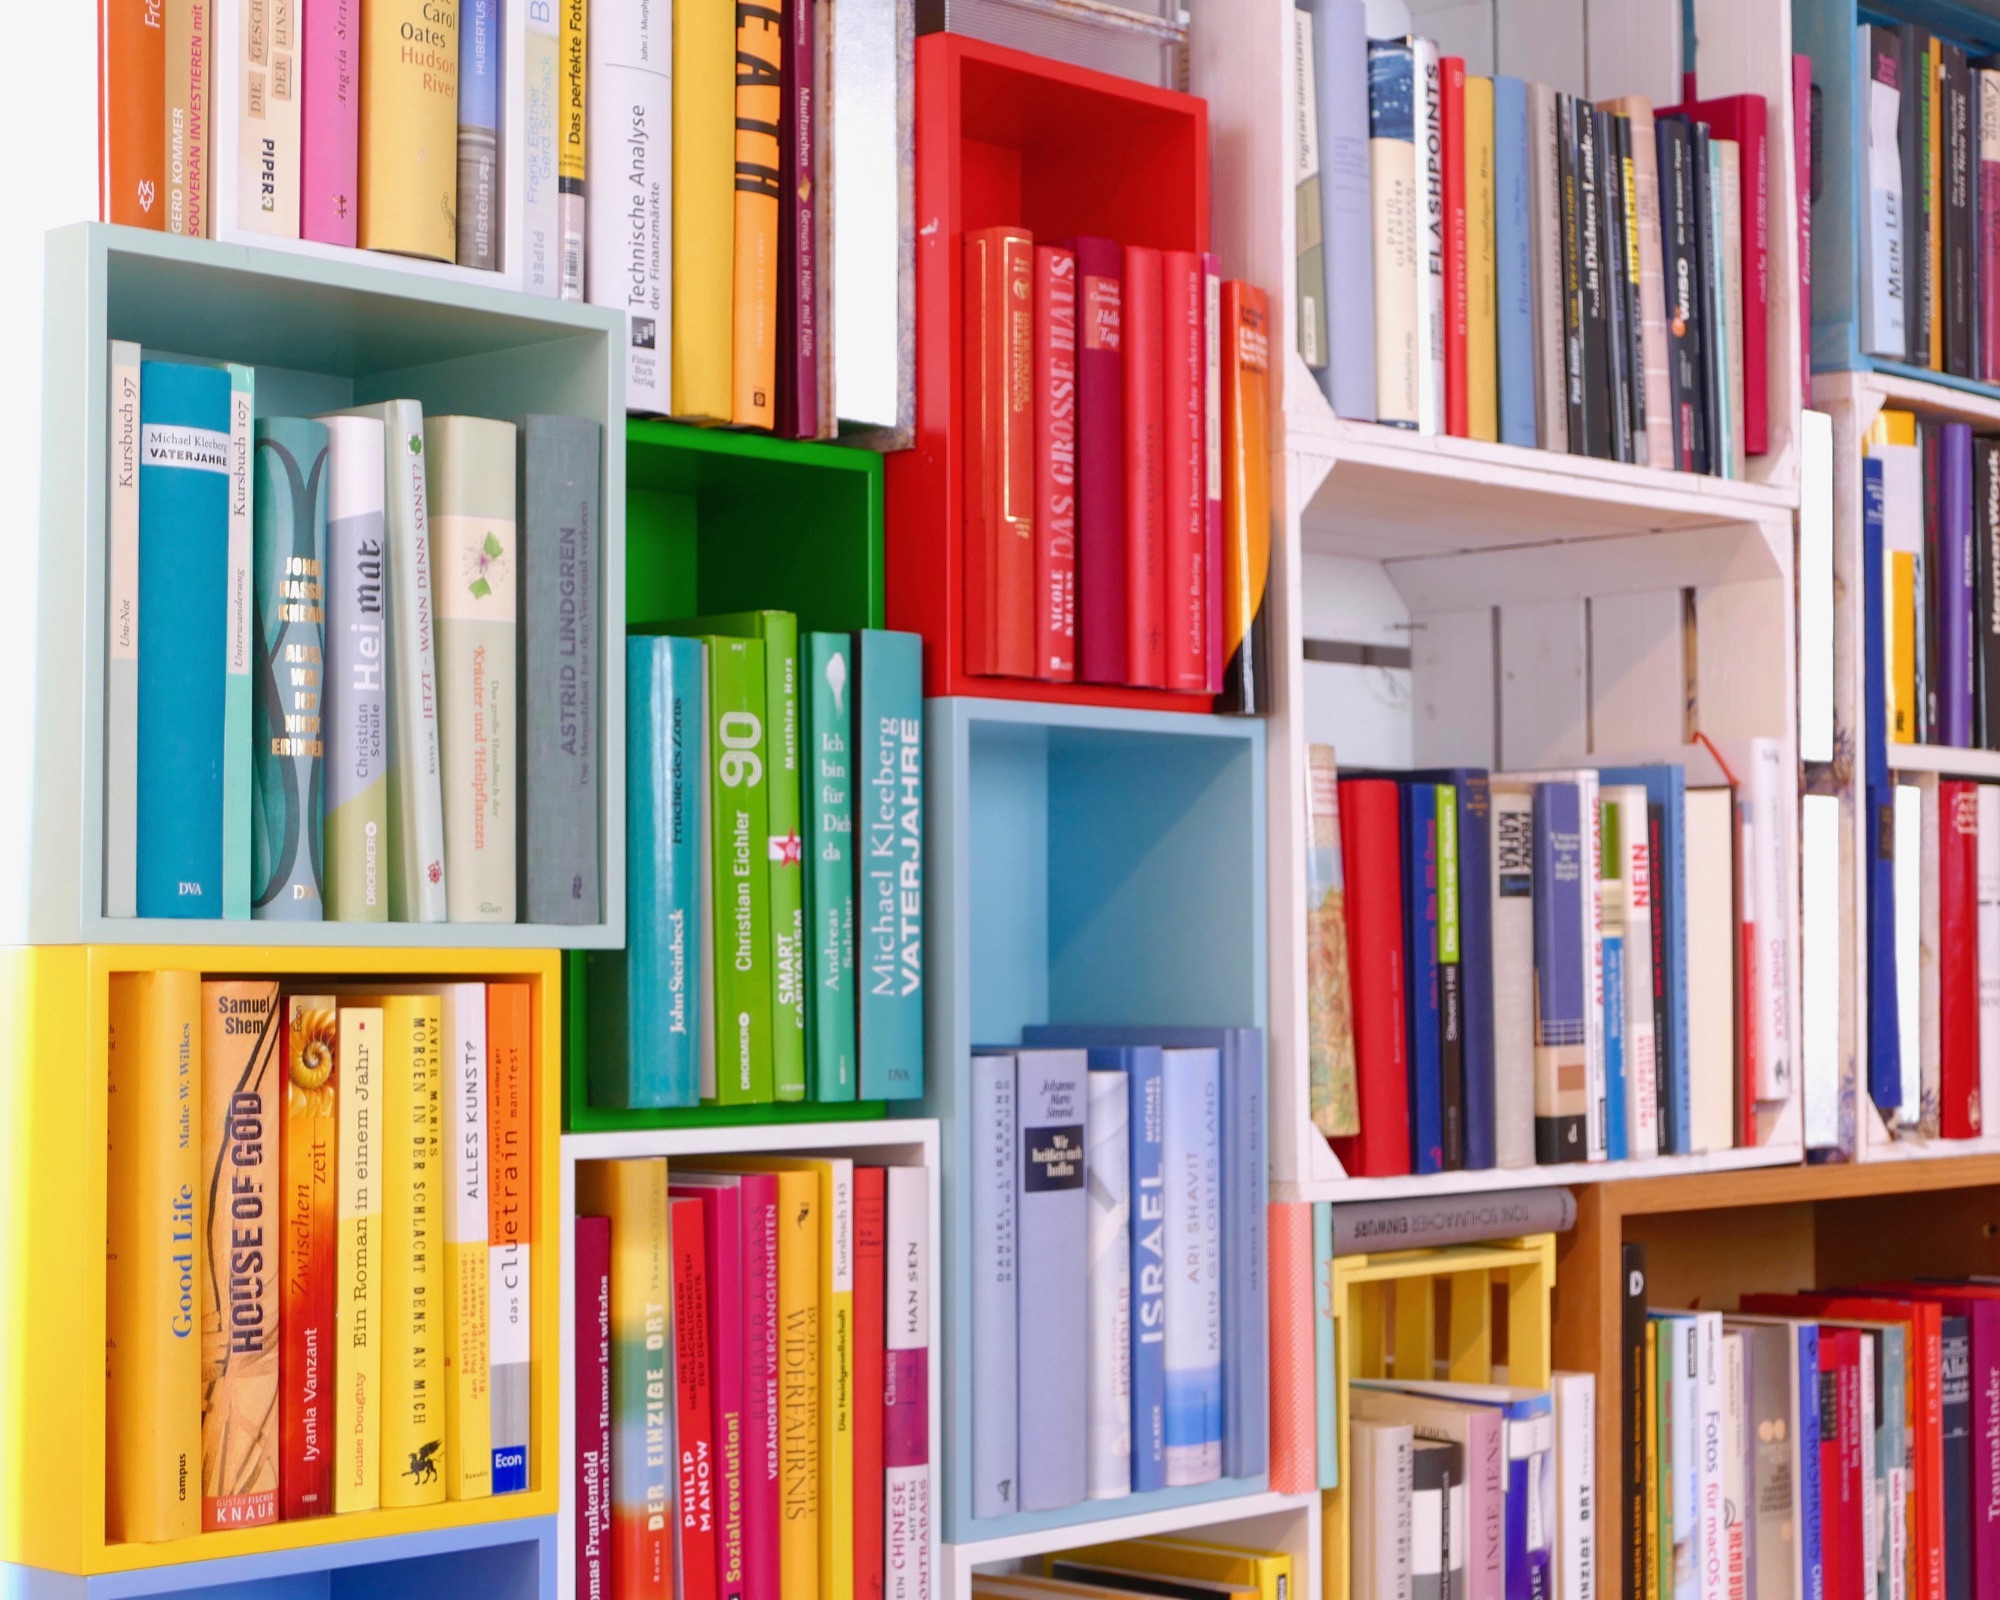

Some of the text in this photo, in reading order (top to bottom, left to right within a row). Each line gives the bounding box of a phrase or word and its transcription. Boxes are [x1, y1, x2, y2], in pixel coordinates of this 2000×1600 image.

[400, 22, 446, 48] Oates
[400, 45, 455, 77] Hudson
[421, 3, 456, 31] Carol
[475, 0, 487, 74] HUBERTUS
[640, 44, 649, 61] John
[187, 4, 203, 236] SOUVERÄN INVESTIEREN mit
[250, 82, 262, 113] DIE
[274, 60, 286, 96] DER
[335, 49, 349, 107] Angela
[422, 72, 456, 100] River
[539, 54, 553, 179] Gerd Schnack
[567, 37, 583, 146] Das perfekte
[171, 108, 184, 234] GERD KOMMER
[262, 138, 275, 195] PIPER
[526, 85, 541, 204] Frank Elstner
[800, 87, 811, 167] Maultaschen
[1426, 64, 1442, 277] FLASHPOINTS
[475, 186, 489, 257] ullstein
[629, 104, 648, 306] Technische Analyse
[648, 182, 661, 311] der Finanzmärkte
[1584, 191, 1599, 269] Dichters
[534, 230, 546, 285] PIPER
[800, 209, 813, 301] Genuss Hülle
[1887, 240, 1902, 300] MEIN
[119, 377, 137, 488] Kursbuch 97
[150, 432, 192, 447] Michael
[1049, 255, 1075, 560] DAS GROSSE HAUS
[150, 448, 228, 467] VATERJAHRE
[233, 401, 250, 517] Kursbuch 107
[234, 568, 246, 669] Unterwanderung
[412, 463, 434, 718] JETZT WANN DENN SONST?
[1050, 568, 1064, 631] NICOLE
[559, 526, 577, 756] ASTRID LINDGREN
[356, 703, 369, 778] Christian
[369, 703, 381, 757] Schüle
[471, 645, 488, 850] Kräuter und Heilpflanzen
[718, 711, 763, 788] 90
[782, 657, 796, 769] Matthias Horx
[822, 732, 843, 752] Ich
[366, 836, 378, 905] DROEMER
[871, 717, 900, 997] Michael Kleeberg
[901, 717, 921, 997] VATERJAHRE
[1499, 812, 1519, 869] KAFKA
[1633, 843, 1650, 908] NEIN
[179, 881, 202, 896] DVA
[732, 809, 752, 971] Christian Eichler
[668, 908, 687, 1035] John Steinbeck
[777, 934, 796, 1005] SMART
[825, 908, 840, 991] Andreas
[218, 996, 270, 1014] Samuel
[225, 1016, 264, 1035] Shem
[1444, 967, 1457, 1041] Steven Hill
[179, 1022, 190, 1149] Malte Wilkes
[464, 1040, 479, 1200] ALLES KUNST?
[308, 1141, 327, 1185] zeit
[353, 1043, 369, 1349] Ein Roman in einem Jahr
[499, 1047, 518, 1324] das cluetrain manifest
[995, 1080, 1004, 1283] DANIEL LIBESKIND
[171, 1183, 193, 1338] Good Life
[230, 1091, 264, 1354] HOUSE OF GOD
[290, 1183, 312, 1298] Zwischen
[412, 1017, 426, 1425] MORGEN DER SCHLACHT DENK AN MICH
[836, 1210, 849, 1276] Kursbuch
[1139, 1162, 1165, 1345] ISRAEL
[1185, 1151, 1201, 1284] ARI SHAVIT
[1204, 1080, 1218, 1351] MEIN GELOBTES LAND
[908, 1241, 918, 1333] HAN SEN
[765, 1204, 778, 1480] VERÄNDERTE VERGANGENHEITEN
[1926, 1336, 1938, 1392] WILSON
[303, 1327, 320, 1461] Iyanla Vanzant
[354, 1371, 366, 1488] Louise Doughty
[597, 1274, 610, 1531] Leben ohne Humor ist witzlos
[645, 1302, 665, 1532] DER EINZIGE ORT
[784, 1308, 808, 1520] WIDERFAHRNIS
[178, 1453, 188, 1501] campus
[495, 1453, 522, 1469] Econ
[681, 1450, 698, 1528] PHILIP
[696, 1440, 712, 1533] MANOW
[1849, 1446, 1860, 1468] Im
[1985, 1366, 2000, 1523] Traumakinder
[215, 1501, 276, 1523] KNAUR
[583, 1450, 600, 1557] Frankenfeld
[723, 1411, 742, 1583] Sozialrevolution!
[892, 1482, 907, 1570] CHINESE
[1485, 1429, 1500, 1572] INGE JENS
[1579, 1484, 1590, 1521] ORT
[1704, 1411, 1720, 1585] Fotos für macOS
